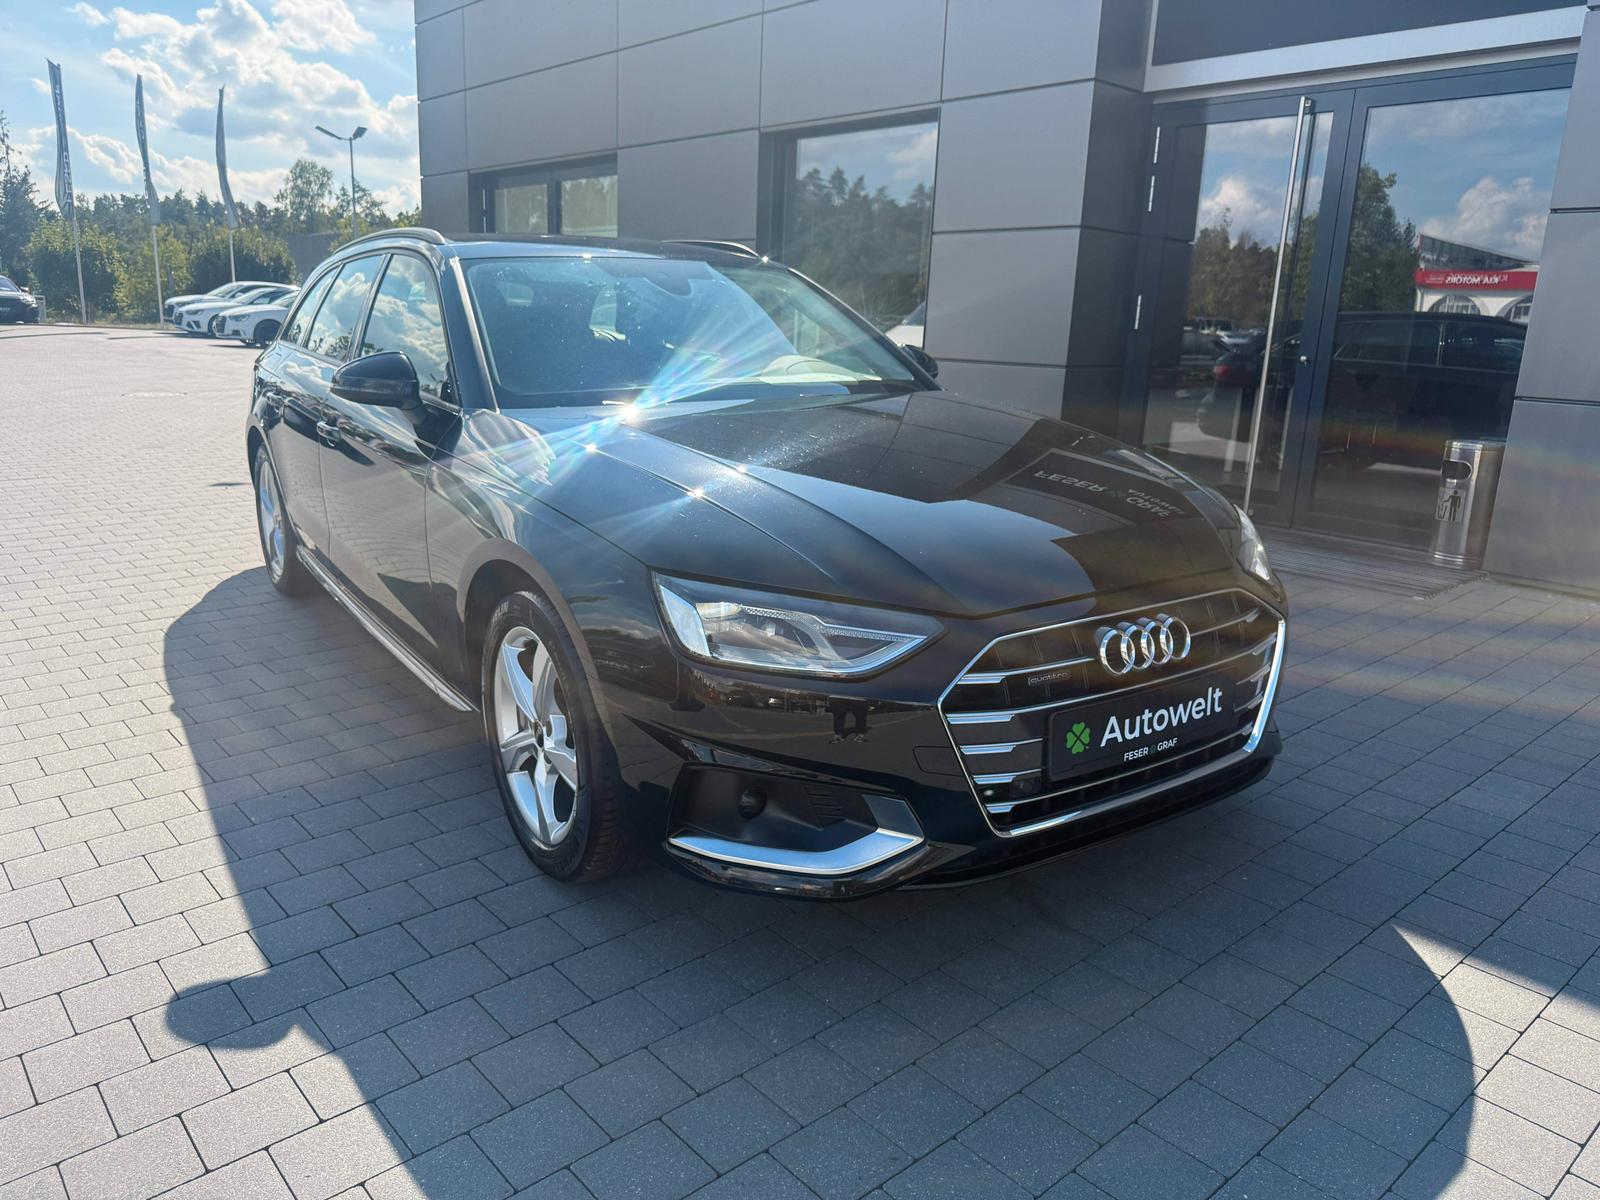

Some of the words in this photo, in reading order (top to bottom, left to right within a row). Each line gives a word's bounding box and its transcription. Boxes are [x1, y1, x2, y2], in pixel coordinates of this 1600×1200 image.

[1100, 686, 1223, 748] Autowelt
[1123, 746, 1149, 762] FESER
[1157, 737, 1178, 752] GRAF
